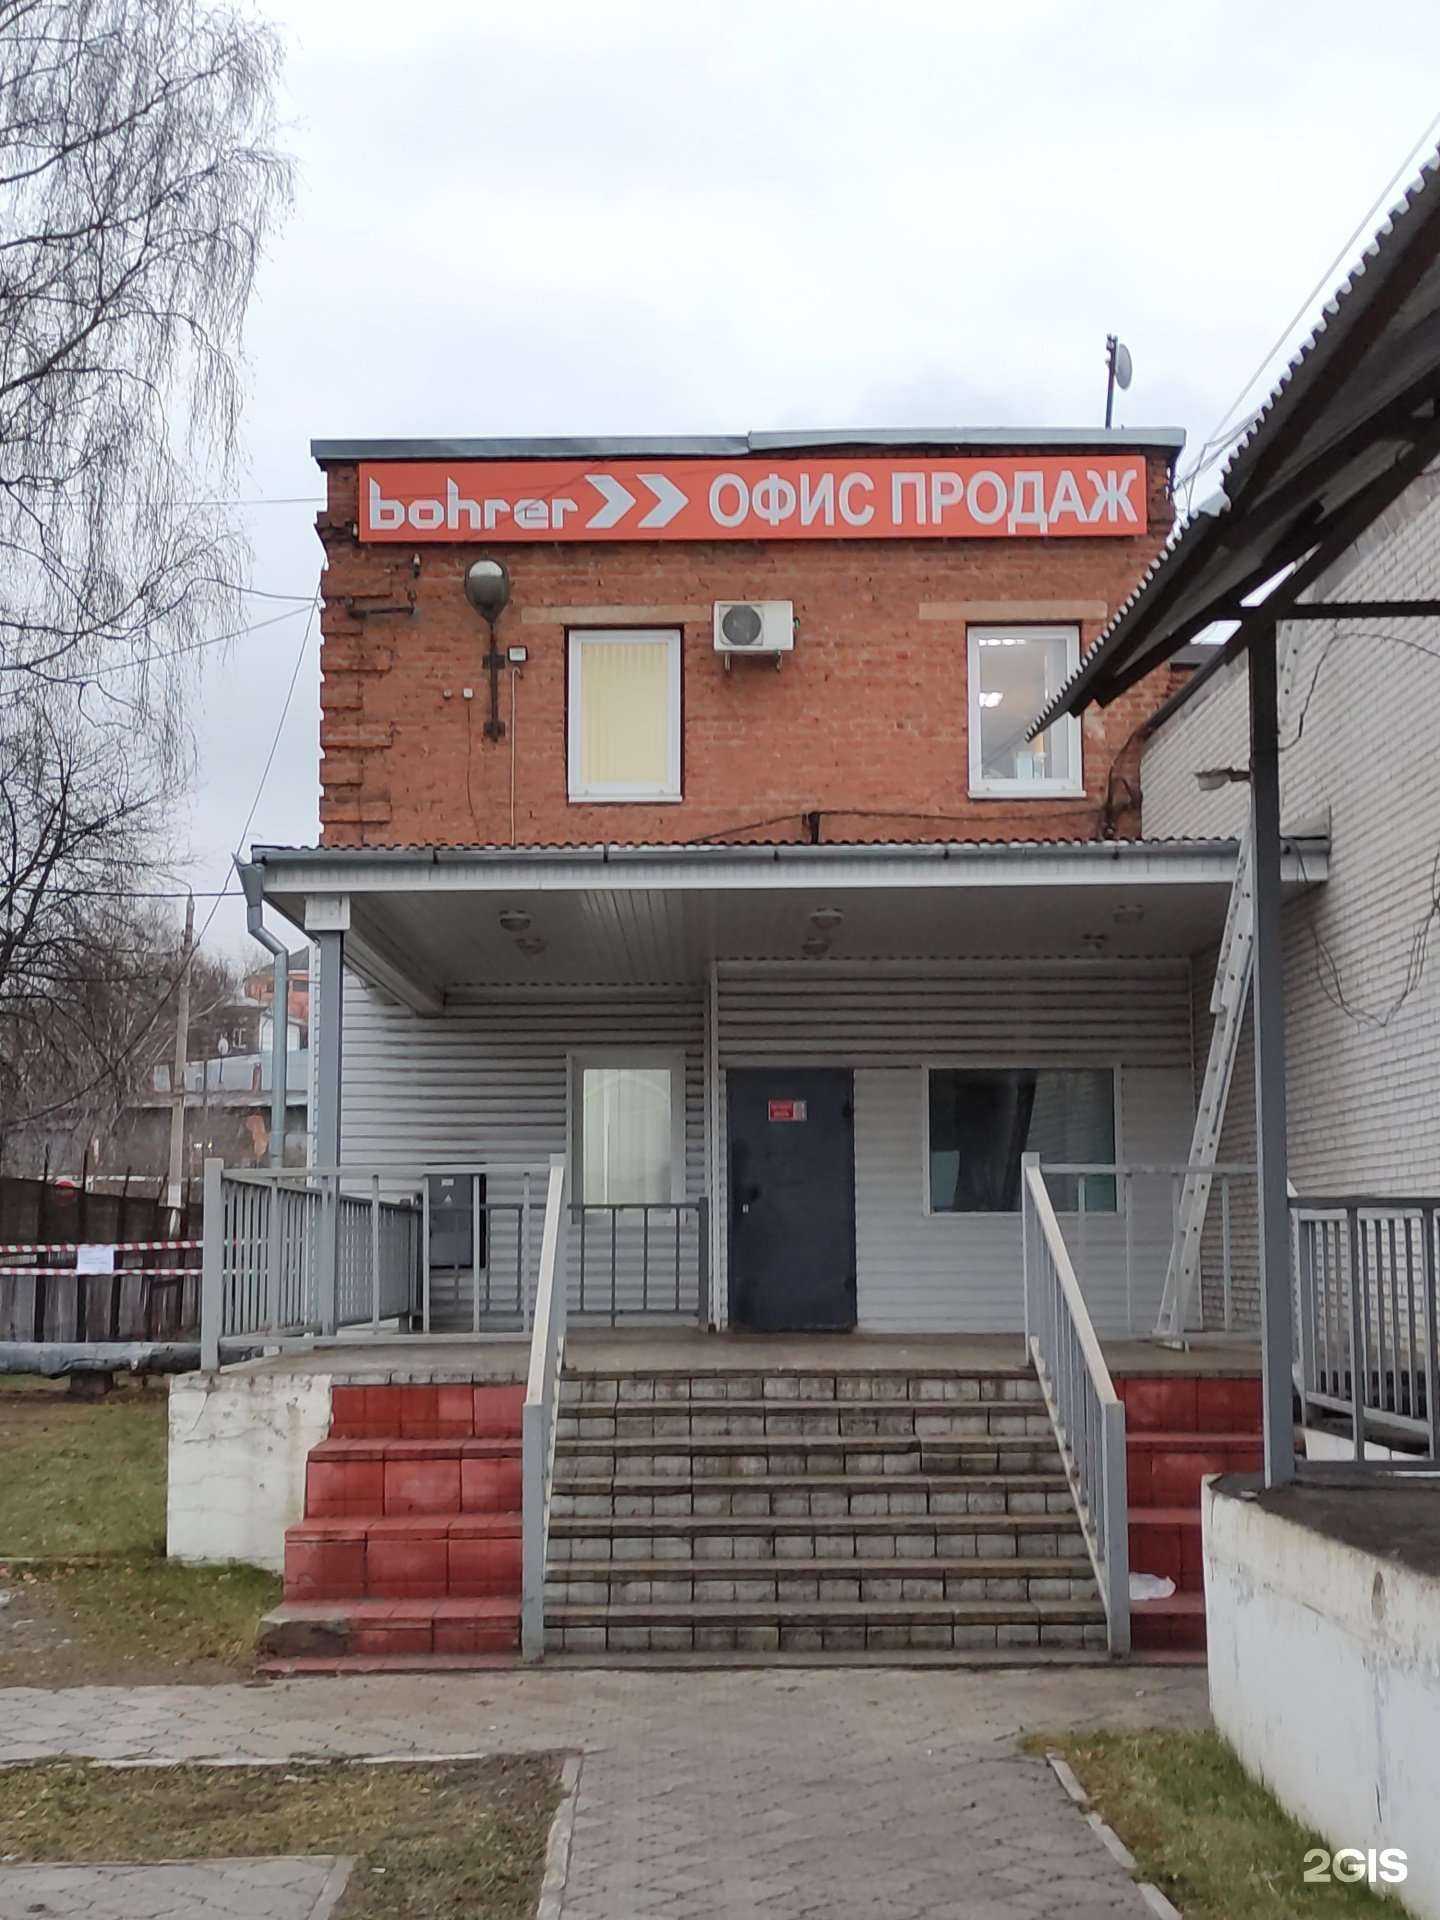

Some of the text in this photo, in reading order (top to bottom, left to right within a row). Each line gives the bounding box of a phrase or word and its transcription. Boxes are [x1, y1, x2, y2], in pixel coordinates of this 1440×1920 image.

[369, 477, 578, 529] bohrer
[709, 469, 1138, 534] ОФИС ПРОДАЖ
